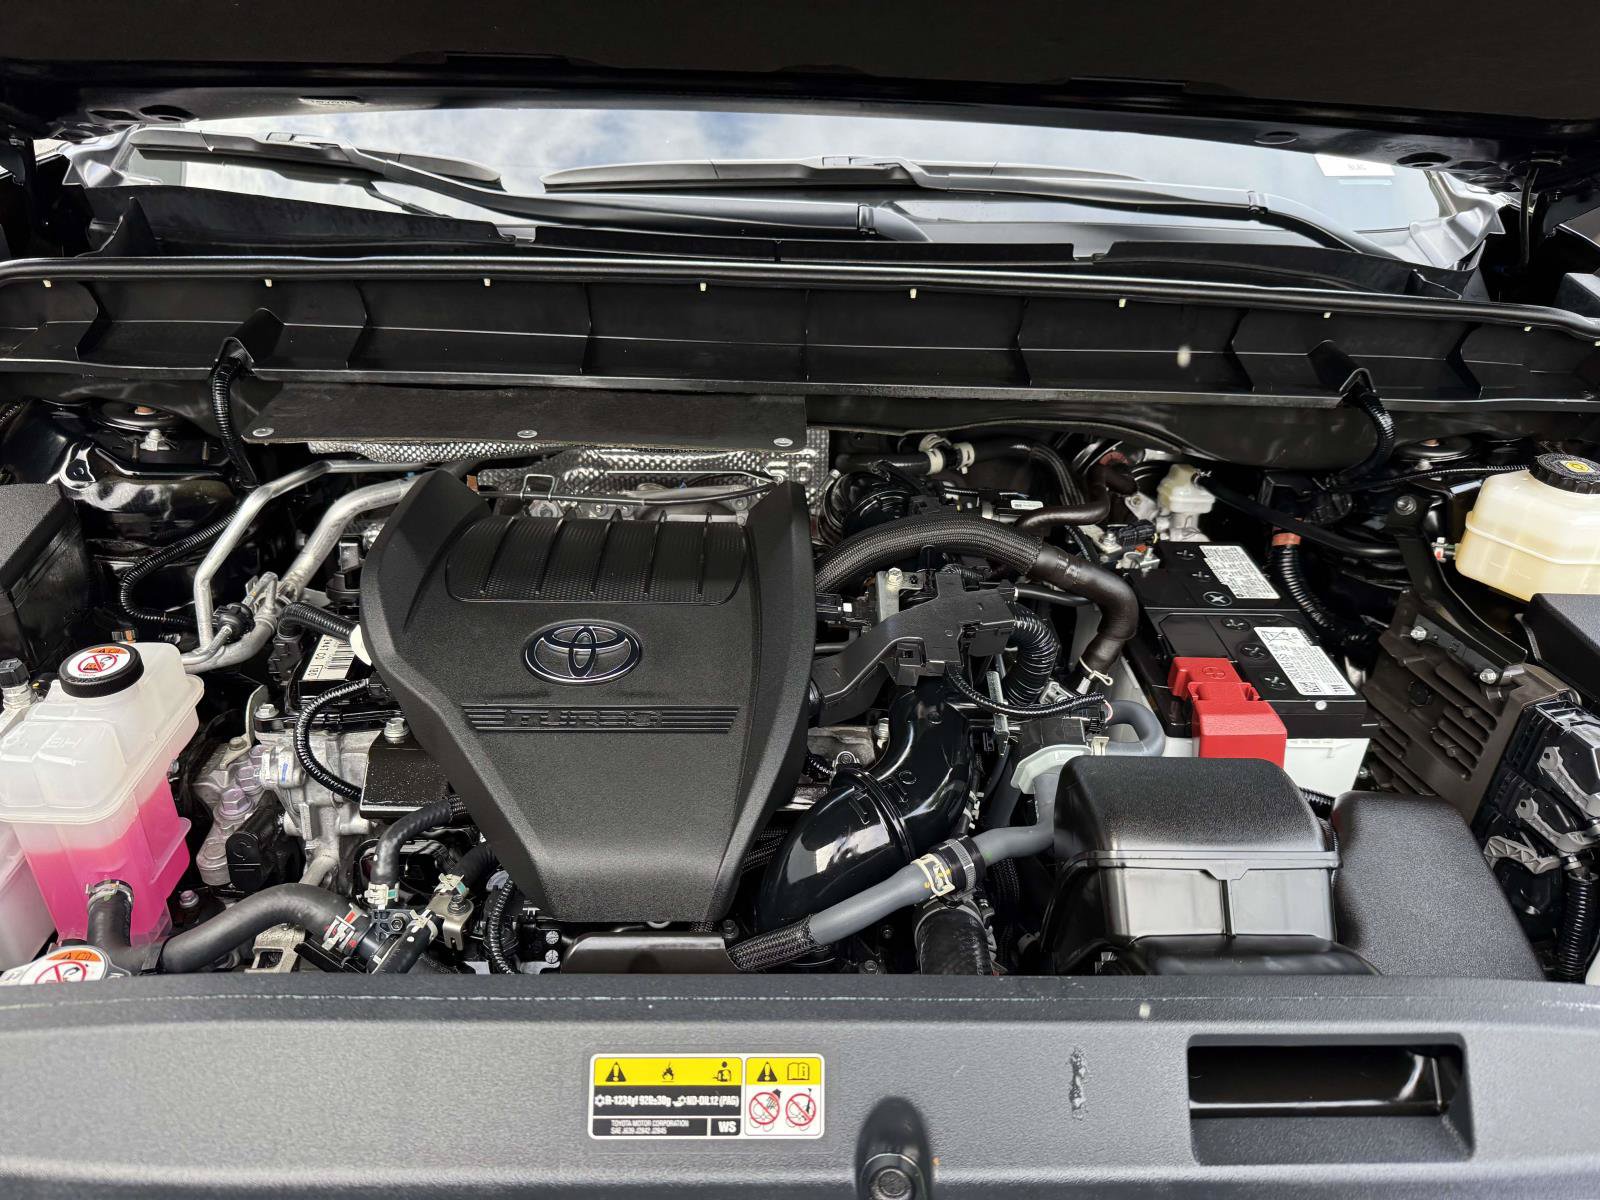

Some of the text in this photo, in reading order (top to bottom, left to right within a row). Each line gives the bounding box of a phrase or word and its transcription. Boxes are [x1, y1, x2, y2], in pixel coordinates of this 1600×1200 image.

[611, 1119, 631, 1127] TOYOTA
[633, 1119, 651, 1127] MOTOR
[718, 1121, 737, 1133] WS
